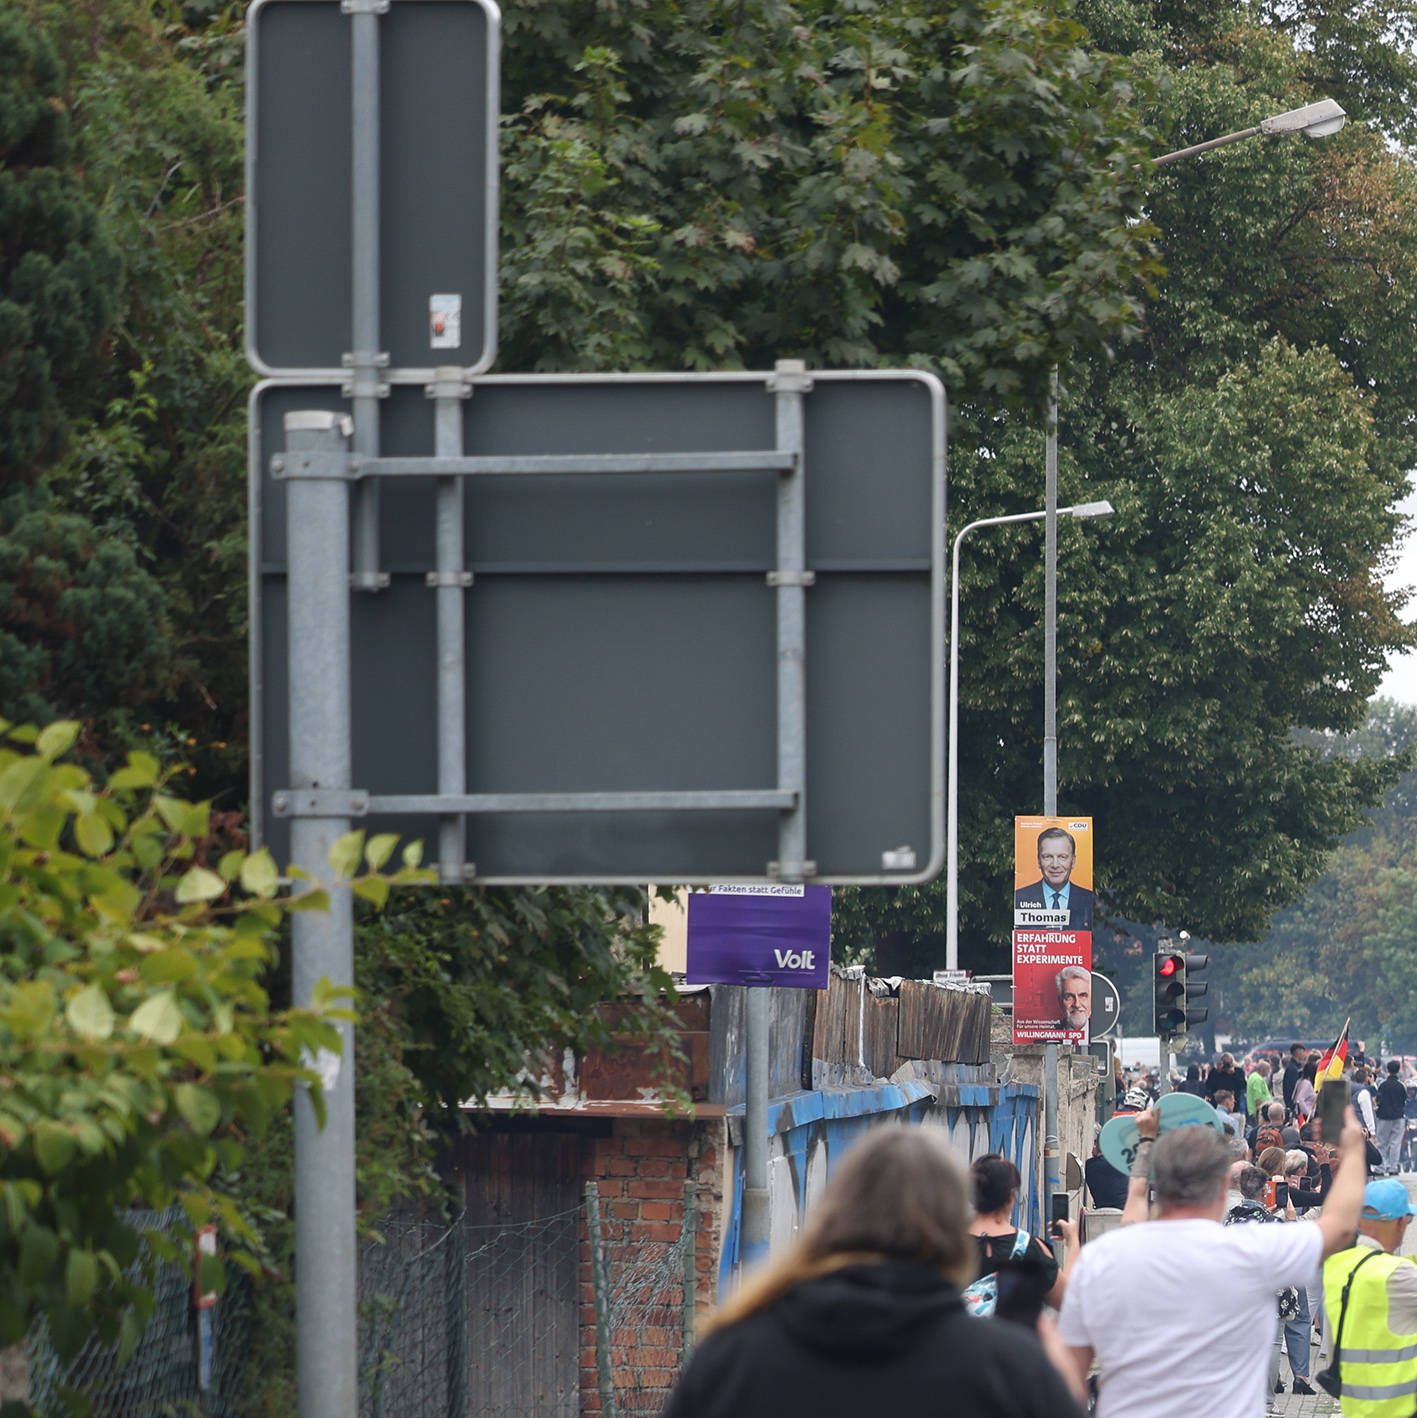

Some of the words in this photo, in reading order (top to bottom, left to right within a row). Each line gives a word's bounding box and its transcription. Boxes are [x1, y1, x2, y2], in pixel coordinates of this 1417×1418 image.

[718, 884, 746, 893] Fakten
[748, 885, 769, 894] statt
[770, 886, 802, 895] Gefühle
[1020, 901, 1042, 909] Ulrich
[1021, 912, 1067, 922] Thomas
[1017, 933, 1076, 943] ERFAHRUNG
[1017, 944, 1047, 953] STATT
[774, 949, 816, 970] Volt
[1017, 954, 1083, 965] EXPERIMENTE
[1016, 1031, 1066, 1039] WILLINGMANN
[1068, 1031, 1082, 1039] SPD
